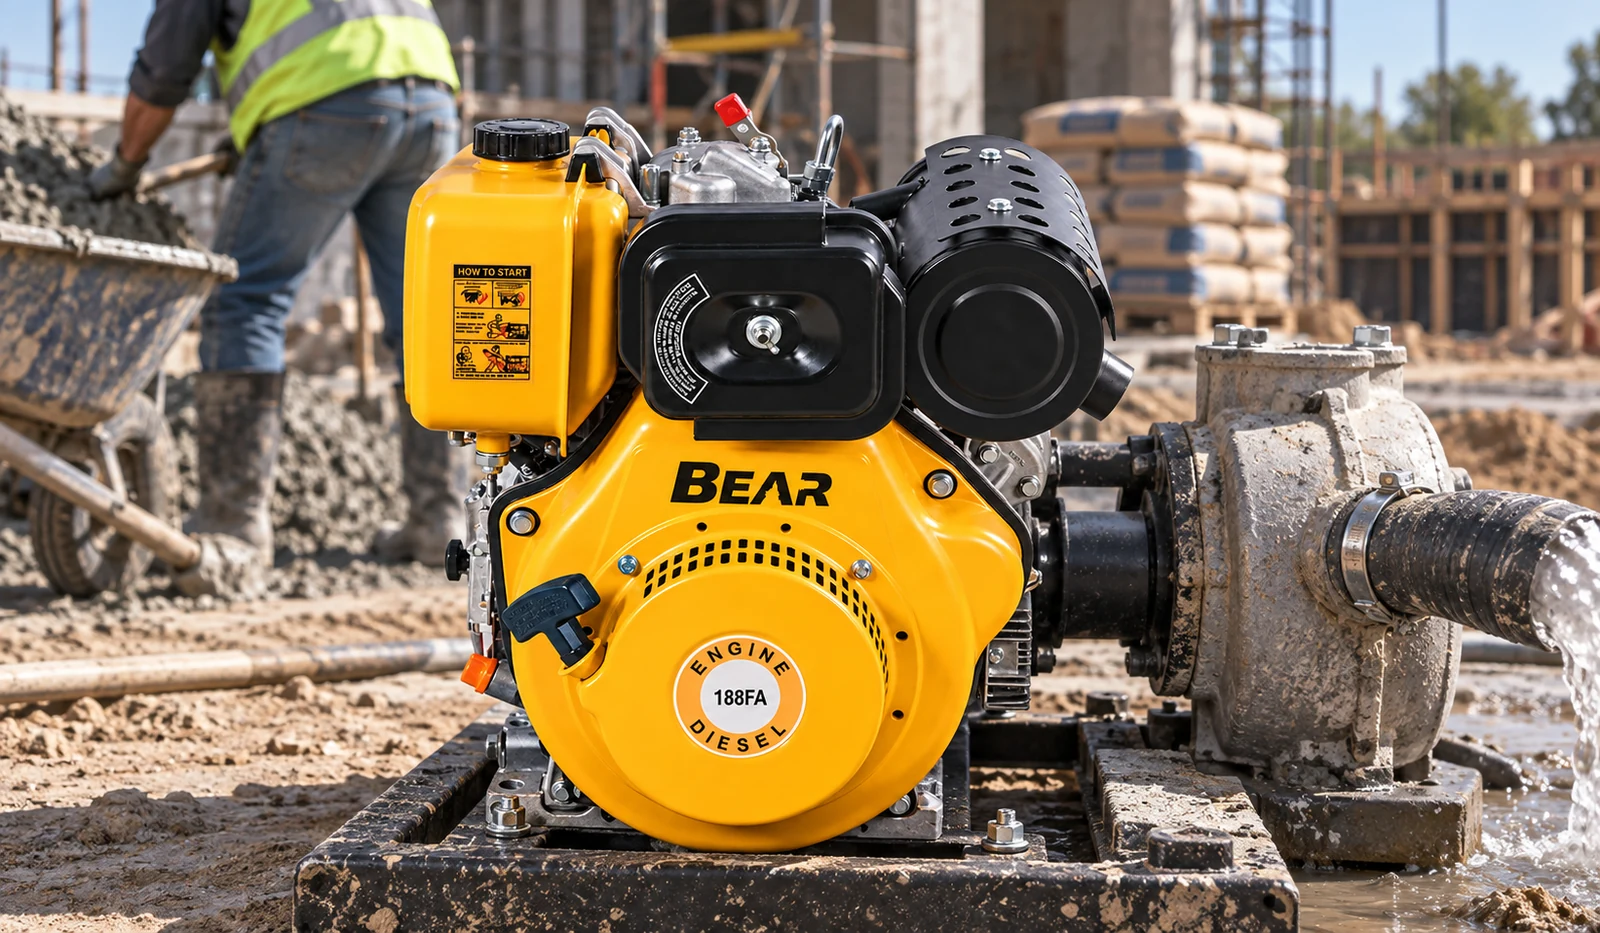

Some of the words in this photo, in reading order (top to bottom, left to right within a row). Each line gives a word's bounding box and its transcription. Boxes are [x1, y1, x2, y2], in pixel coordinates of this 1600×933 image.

[458, 268, 480, 276] HOW
[482, 268, 495, 277] TO
[497, 268, 528, 277] START
[670, 461, 833, 506] BEAR
[690, 641, 790, 676] ENGINE
[713, 689, 768, 706] 188FA
[689, 719, 787, 752] DIESEL
